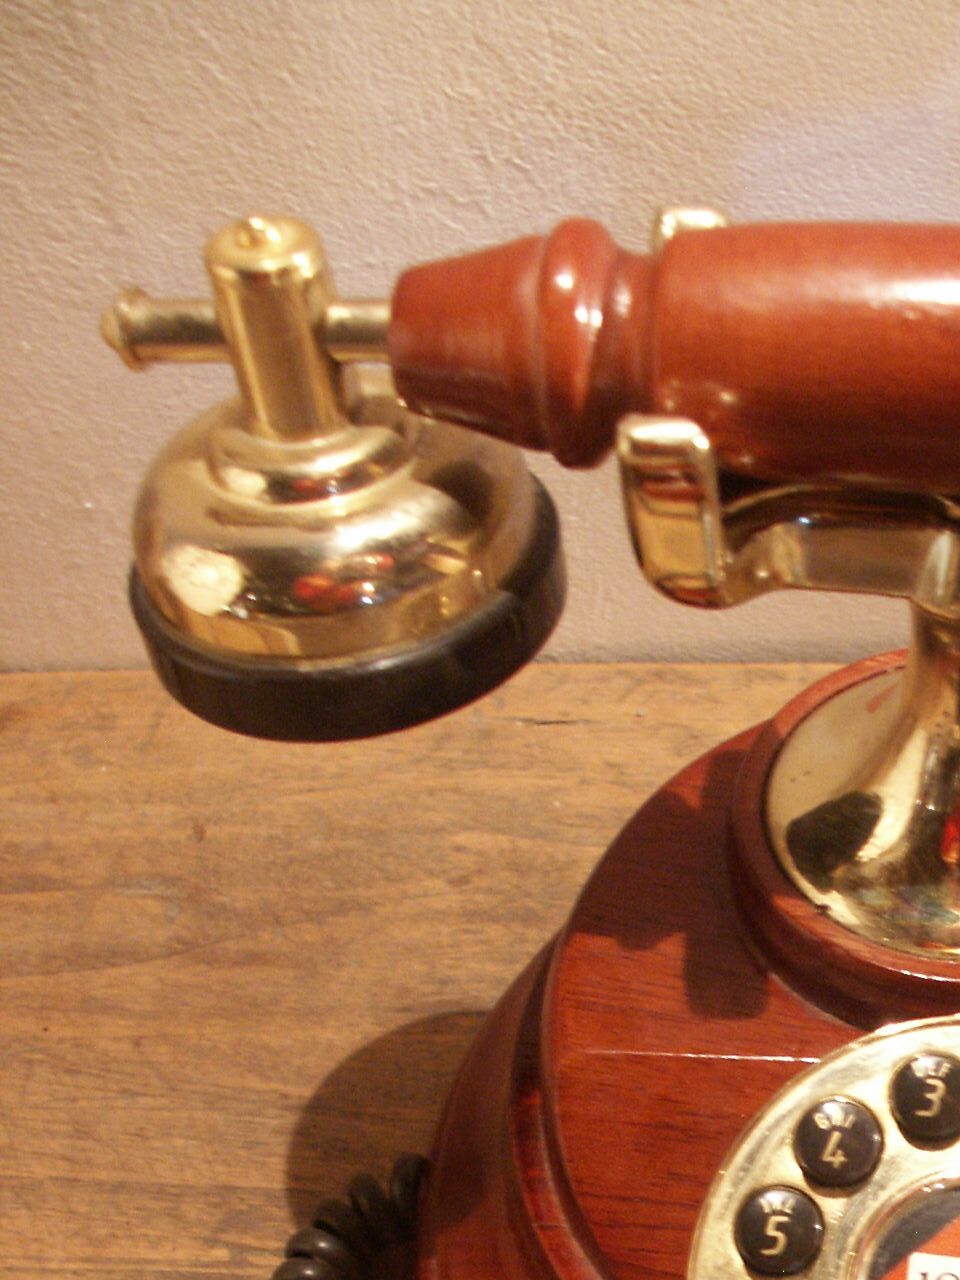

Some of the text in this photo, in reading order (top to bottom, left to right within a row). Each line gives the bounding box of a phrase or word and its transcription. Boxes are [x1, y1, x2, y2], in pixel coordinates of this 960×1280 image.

[914, 1077, 948, 1118] 3
[822, 1131, 849, 1169] 4
[760, 1215, 792, 1257] 5
